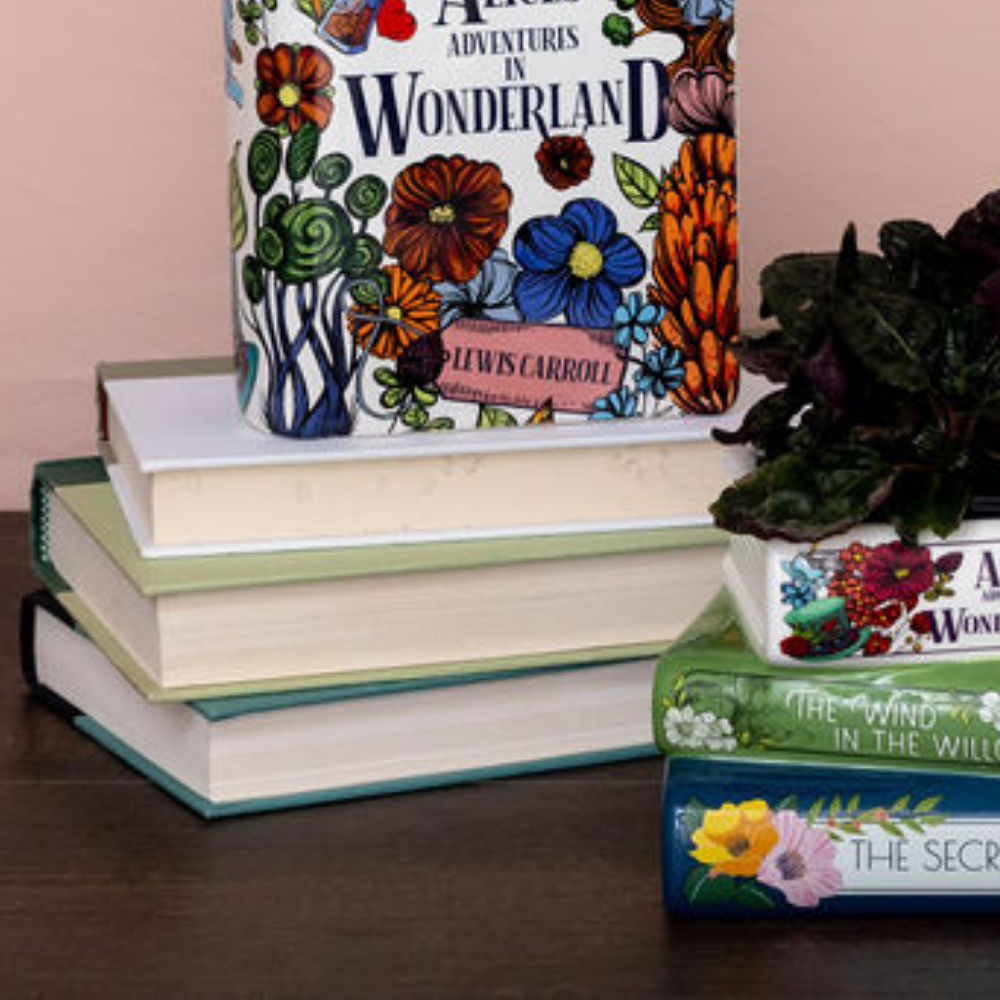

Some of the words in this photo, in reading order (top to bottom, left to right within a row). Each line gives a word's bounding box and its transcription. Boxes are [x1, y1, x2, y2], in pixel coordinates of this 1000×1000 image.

[448, 25, 580, 57] ADVENTURES
[504, 57, 526, 80] IN
[341, 57, 670, 157] WONDERLAND
[452, 347, 517, 376] LEWIS
[519, 353, 611, 384] CARROLL
[786, 687, 837, 723] THE
[850, 690, 937, 730] WIND
[834, 727, 859, 753] IN
[874, 729, 919, 757] THE
[850, 839, 909, 871] THE
